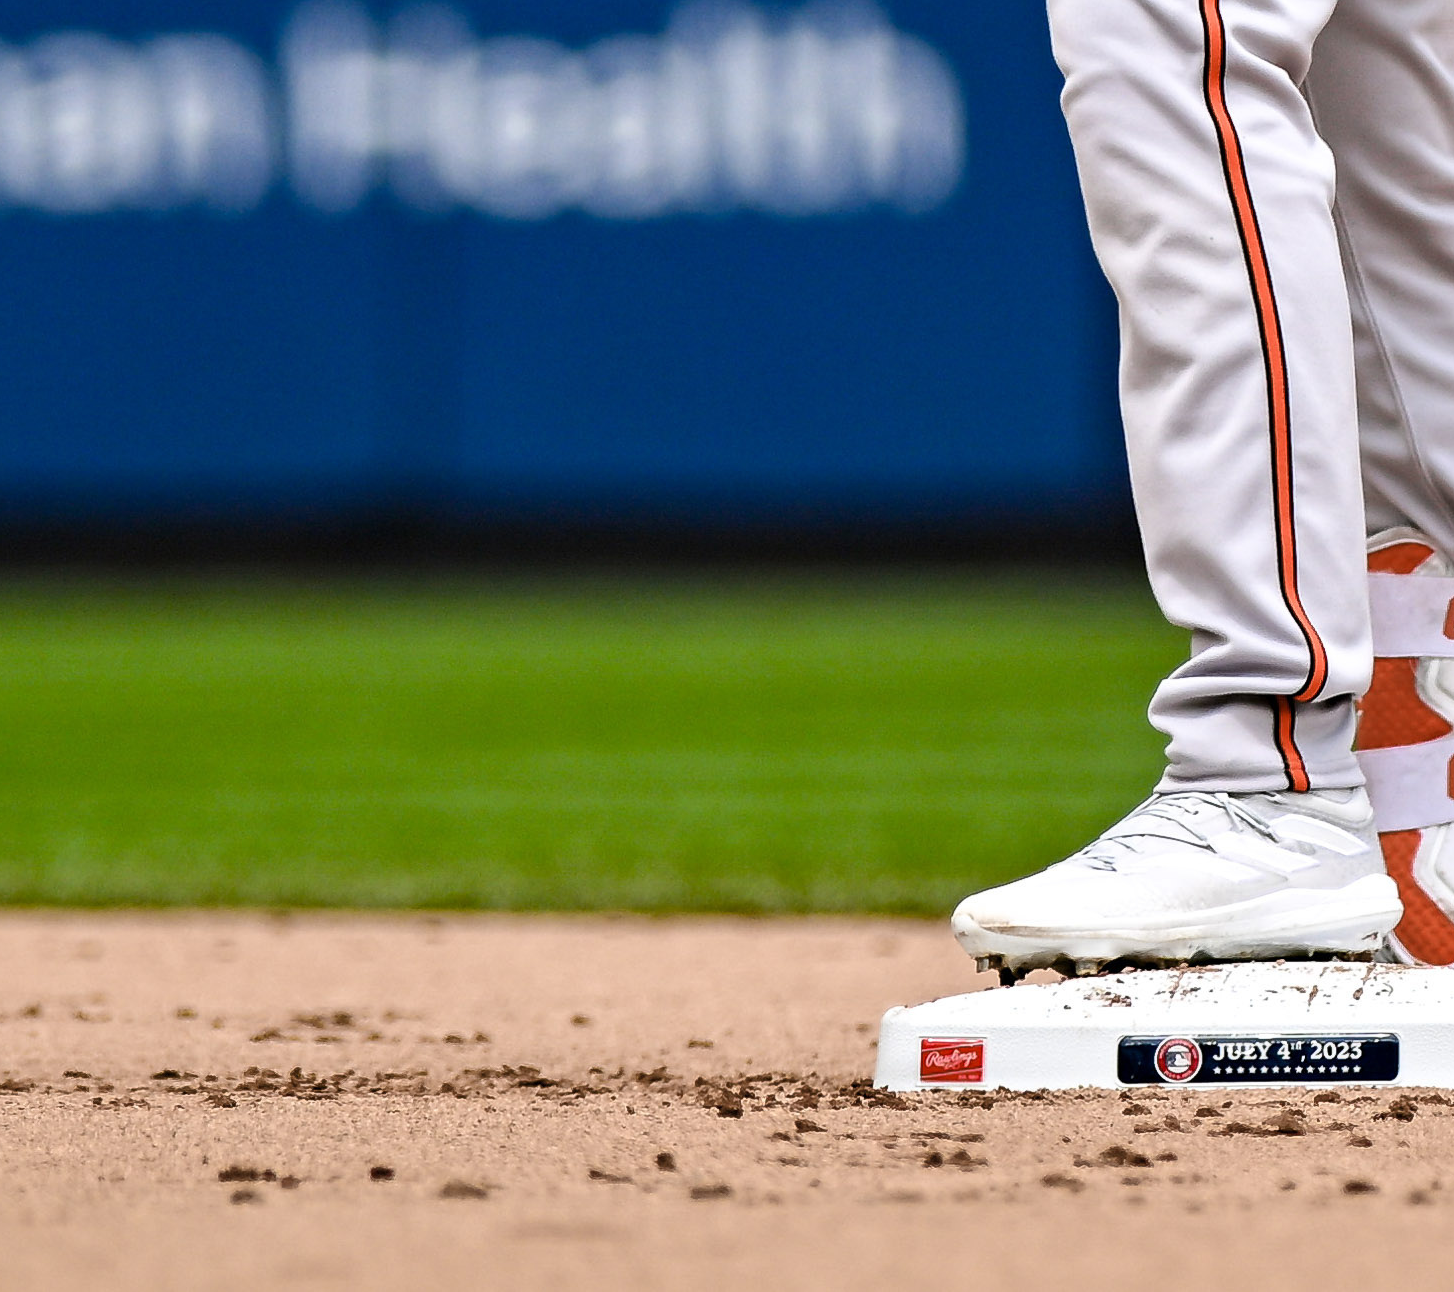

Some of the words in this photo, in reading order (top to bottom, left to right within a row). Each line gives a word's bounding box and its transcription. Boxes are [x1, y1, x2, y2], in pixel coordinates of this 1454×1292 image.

[925, 1048, 978, 1070] Rawlings
[1212, 1041, 1272, 1061] JULY
[1310, 1040, 1363, 1060] 2023
